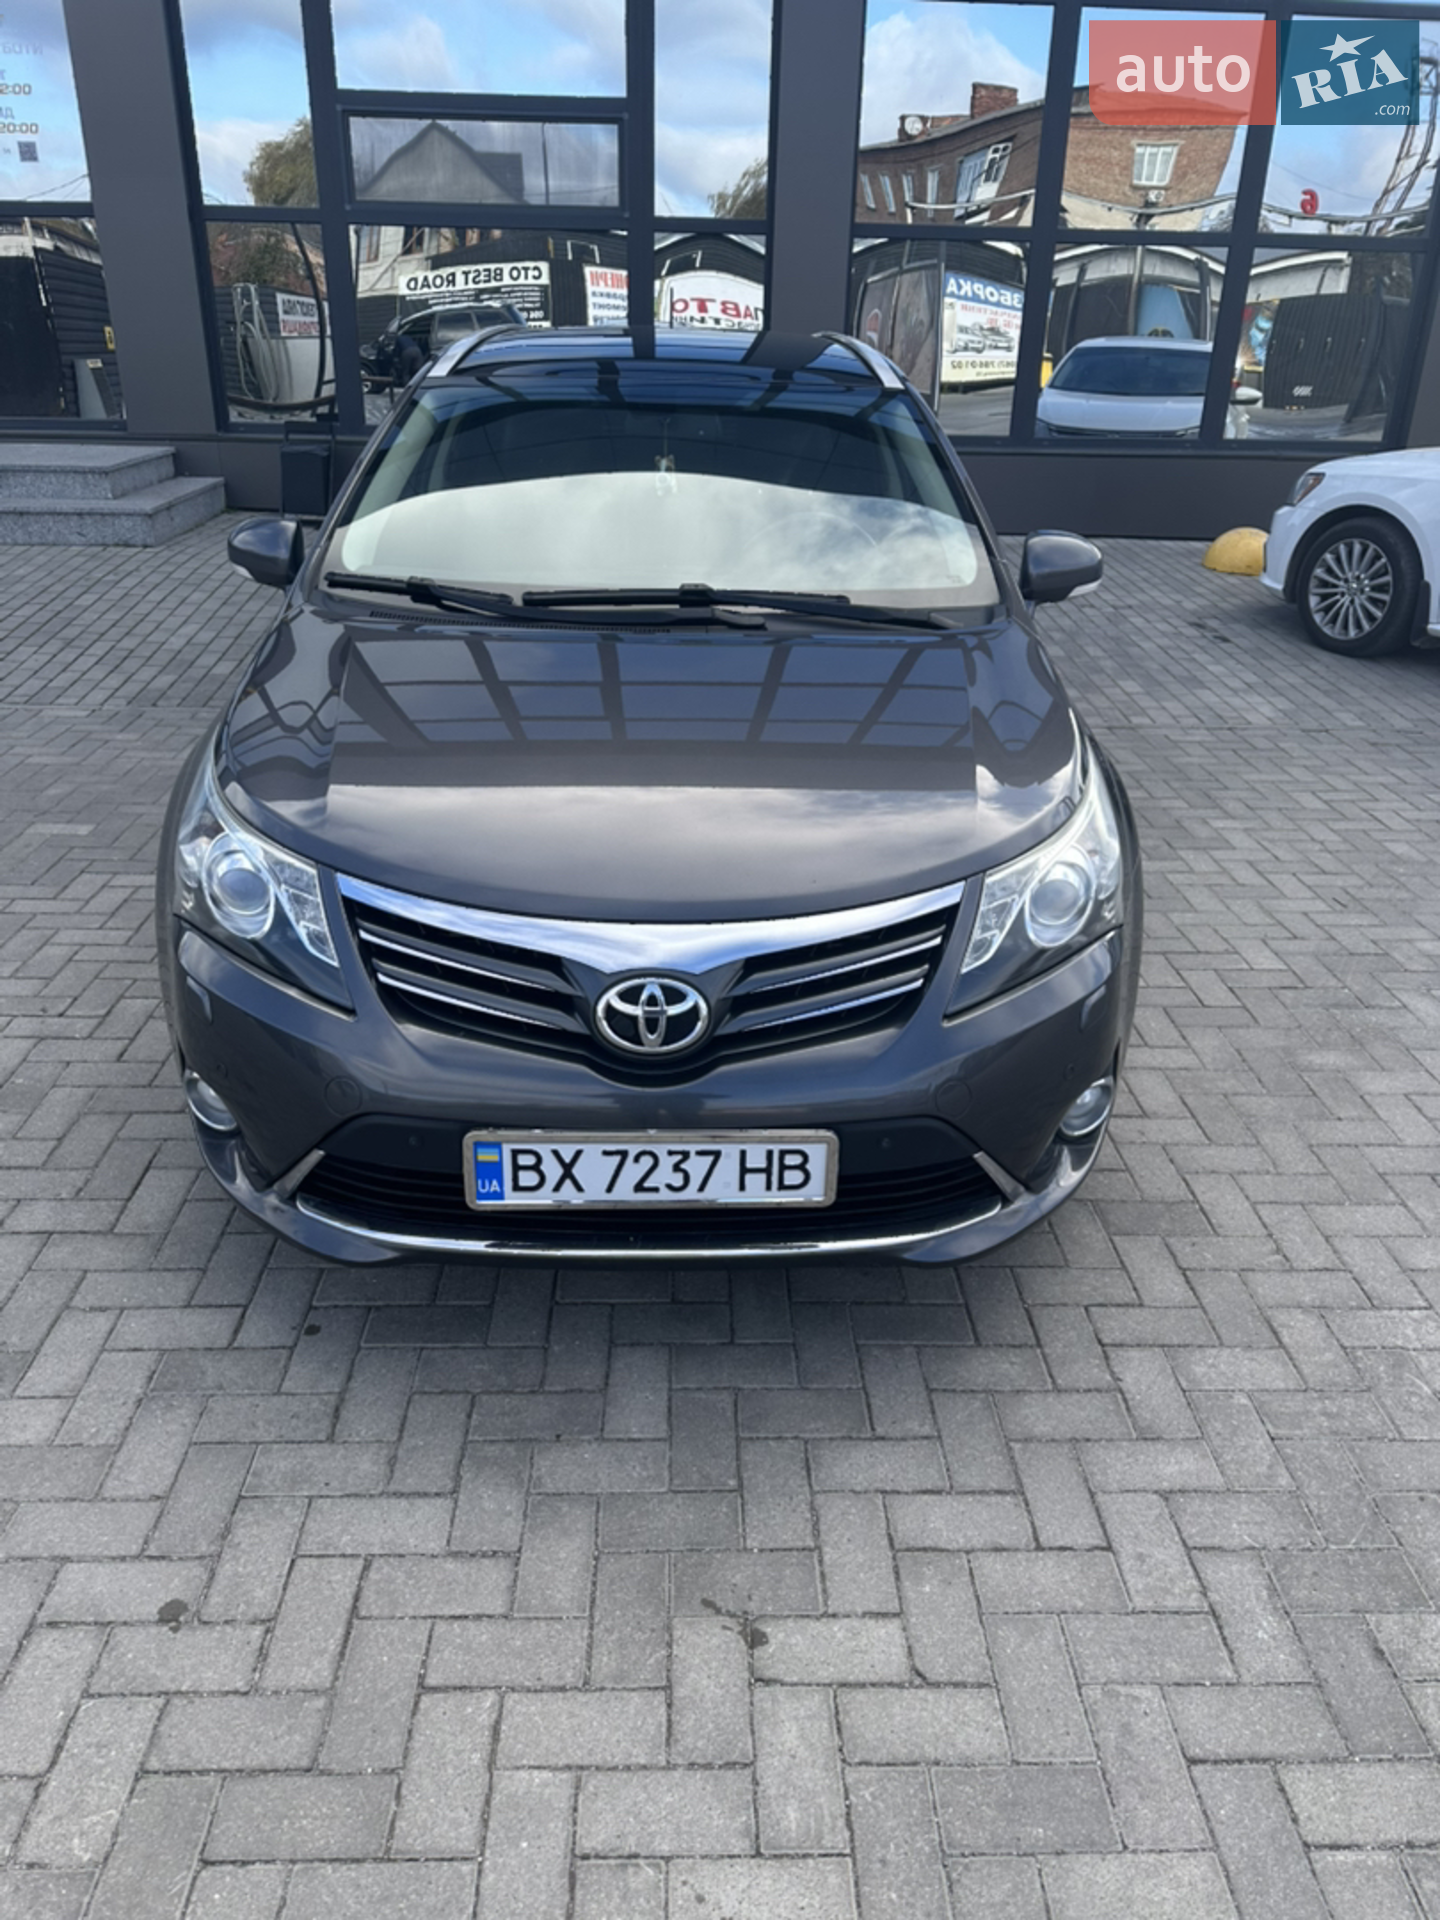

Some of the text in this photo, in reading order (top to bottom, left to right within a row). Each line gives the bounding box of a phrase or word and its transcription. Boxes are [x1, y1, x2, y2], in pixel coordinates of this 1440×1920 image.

[477, 1148, 812, 1194] UA BX 7237 HB
